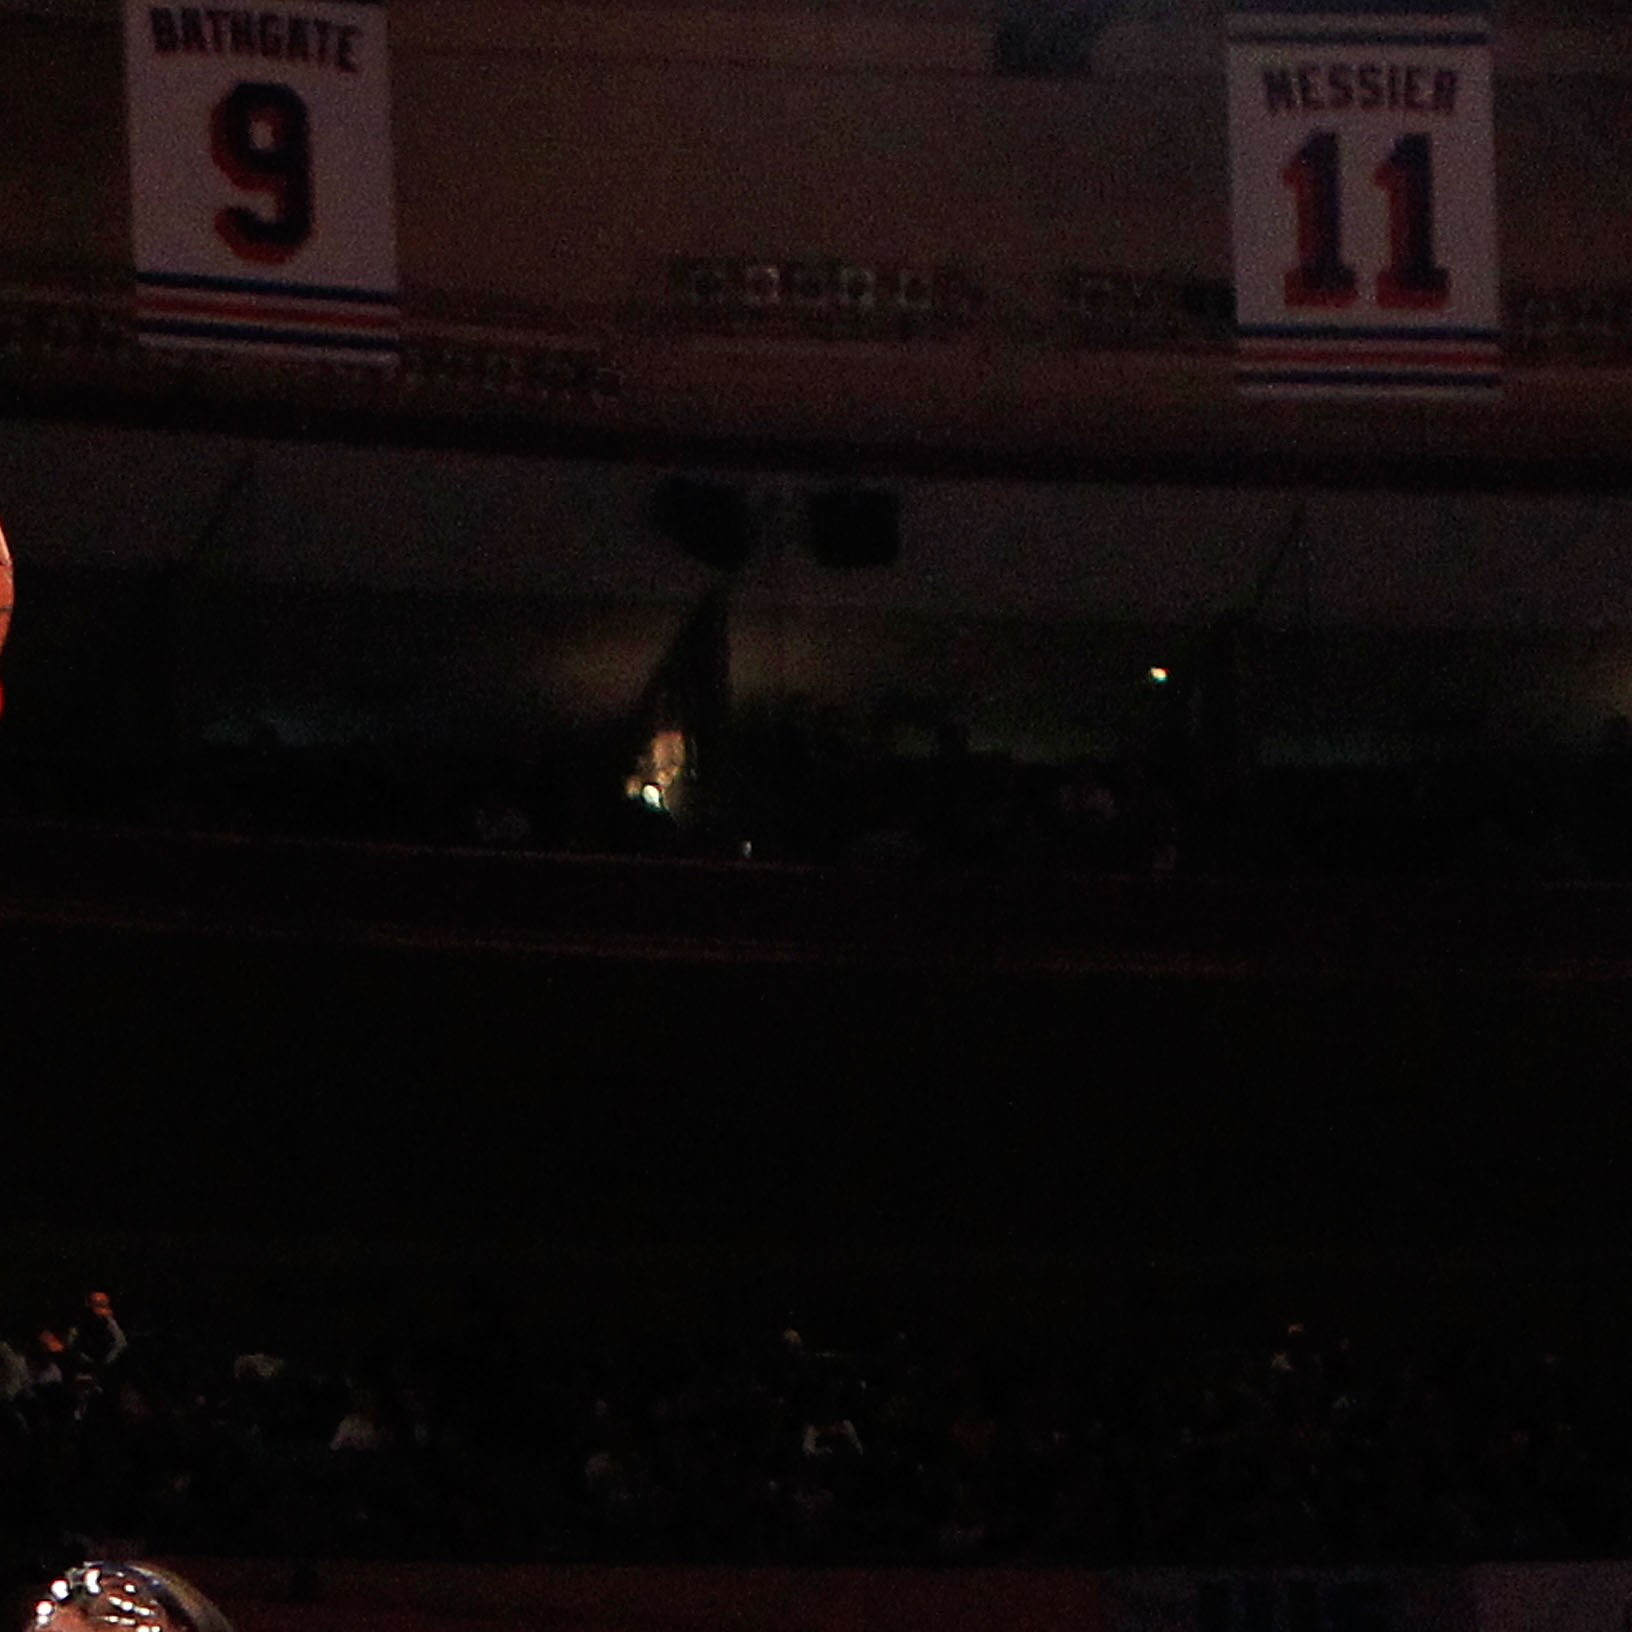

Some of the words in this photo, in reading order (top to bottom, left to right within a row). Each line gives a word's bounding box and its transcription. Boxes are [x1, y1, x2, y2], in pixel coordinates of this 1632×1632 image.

[150, 7, 362, 74] BATHGATE
[1264, 64, 1458, 114] MESSIER
[211, 83, 313, 262] 9
[1281, 130, 1450, 310] 11
